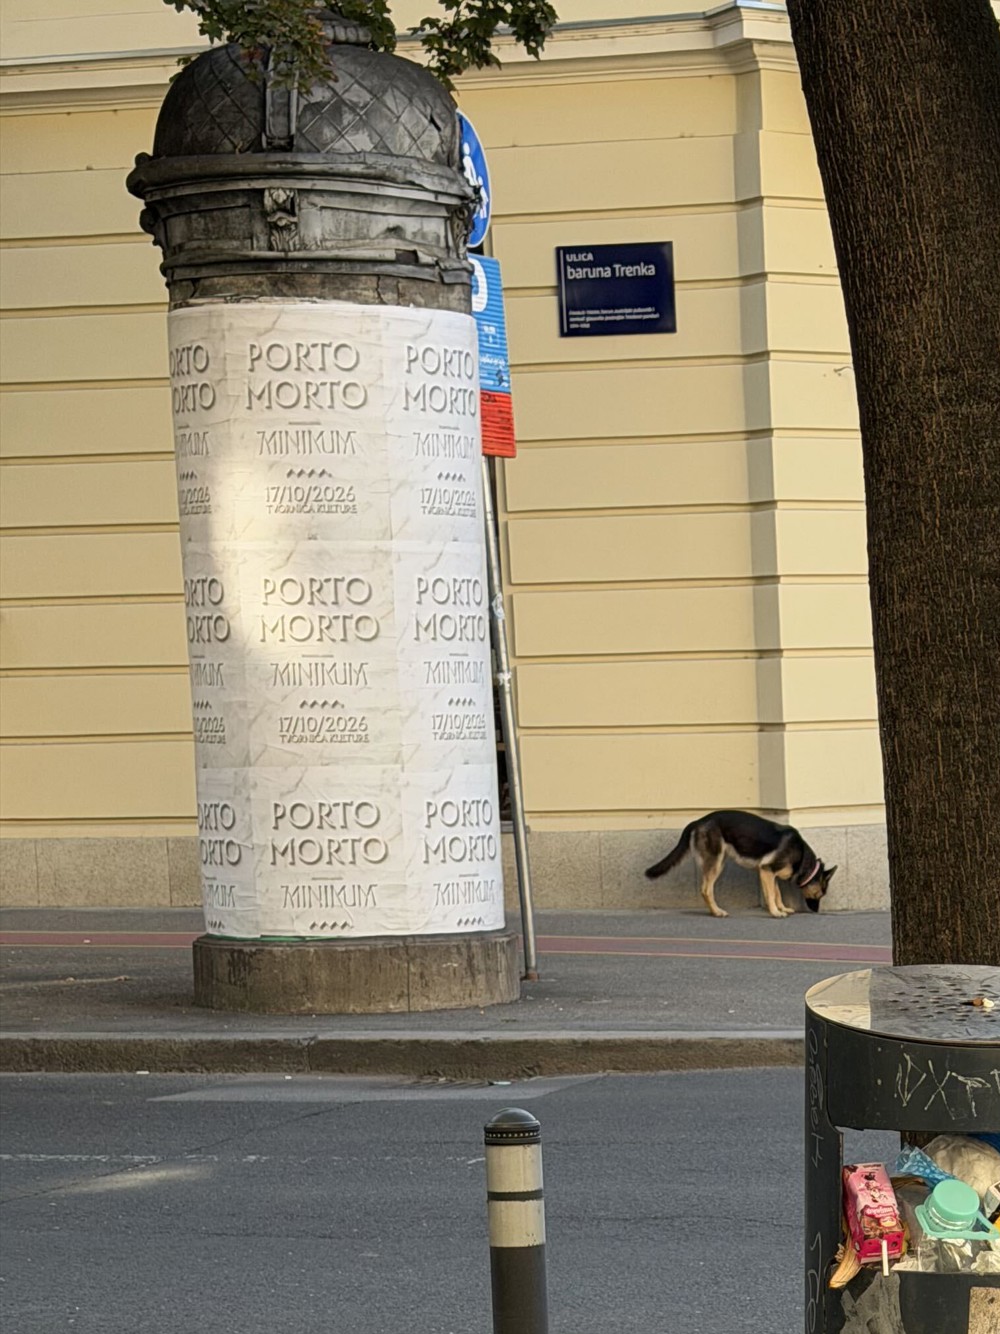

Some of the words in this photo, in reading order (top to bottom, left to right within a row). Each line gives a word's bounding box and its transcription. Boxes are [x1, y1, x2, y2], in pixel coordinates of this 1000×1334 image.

[566, 253, 594, 262] ULICA
[566, 265, 611, 279] baruna
[613, 262, 656, 277] Trenka
[169, 343, 210, 375] ORTO
[248, 342, 360, 372] PORTO
[405, 346, 475, 380] PORTO
[173, 381, 216, 413] ORTO
[245, 381, 368, 410] MORTO
[403, 381, 477, 418] MORTO
[265, 486, 356, 504] 17/10/2026
[421, 488, 476, 509] 17/10/2026
[184, 577, 224, 606] ORTO
[262, 577, 372, 606] PORTO
[416, 576, 483, 606] PORTO
[188, 612, 230, 644] ORTO
[259, 613, 381, 644] MORTO
[414, 612, 486, 643] MORTO
[278, 716, 368, 734] 17/10/2026
[432, 713, 486, 732] 17/10/2026
[197, 801, 236, 831] ORTO
[272, 801, 381, 830] PORTO
[425, 799, 493, 829] PORTO
[202, 837, 242, 867] ORTO
[270, 837, 389, 866] MORTO
[423, 834, 497, 864] MORTO
